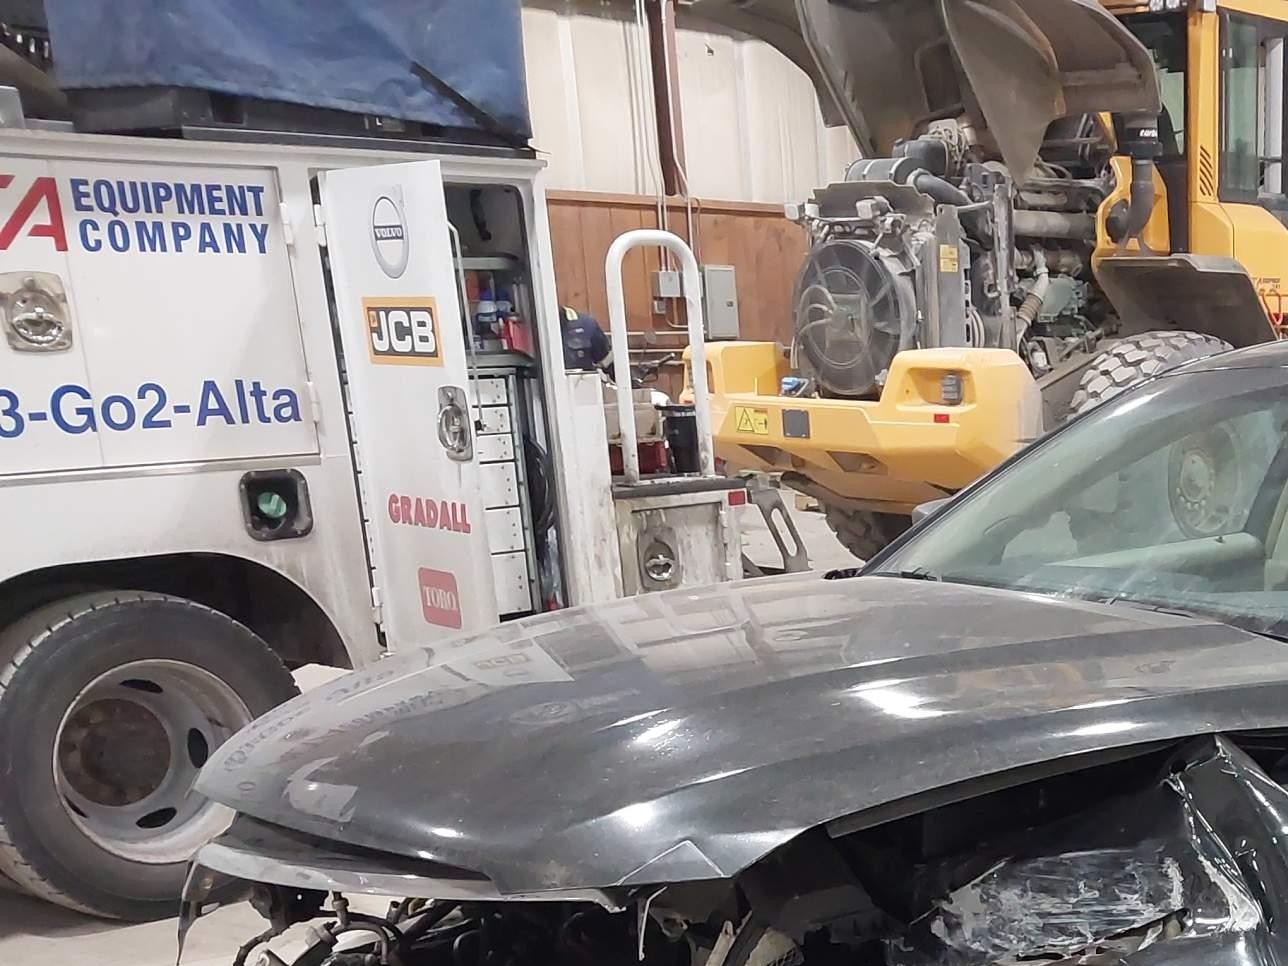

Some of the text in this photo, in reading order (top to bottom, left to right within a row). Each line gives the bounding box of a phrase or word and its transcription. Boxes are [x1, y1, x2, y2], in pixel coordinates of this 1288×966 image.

[70, 178, 265, 218] EQUIPMENT
[78, 219, 269, 254] COMPANY
[374, 227, 403, 239] VOLVO
[369, 310, 436, 353] JCB
[388, 493, 471, 534] GRADALL
[423, 585, 457, 611] TORO
